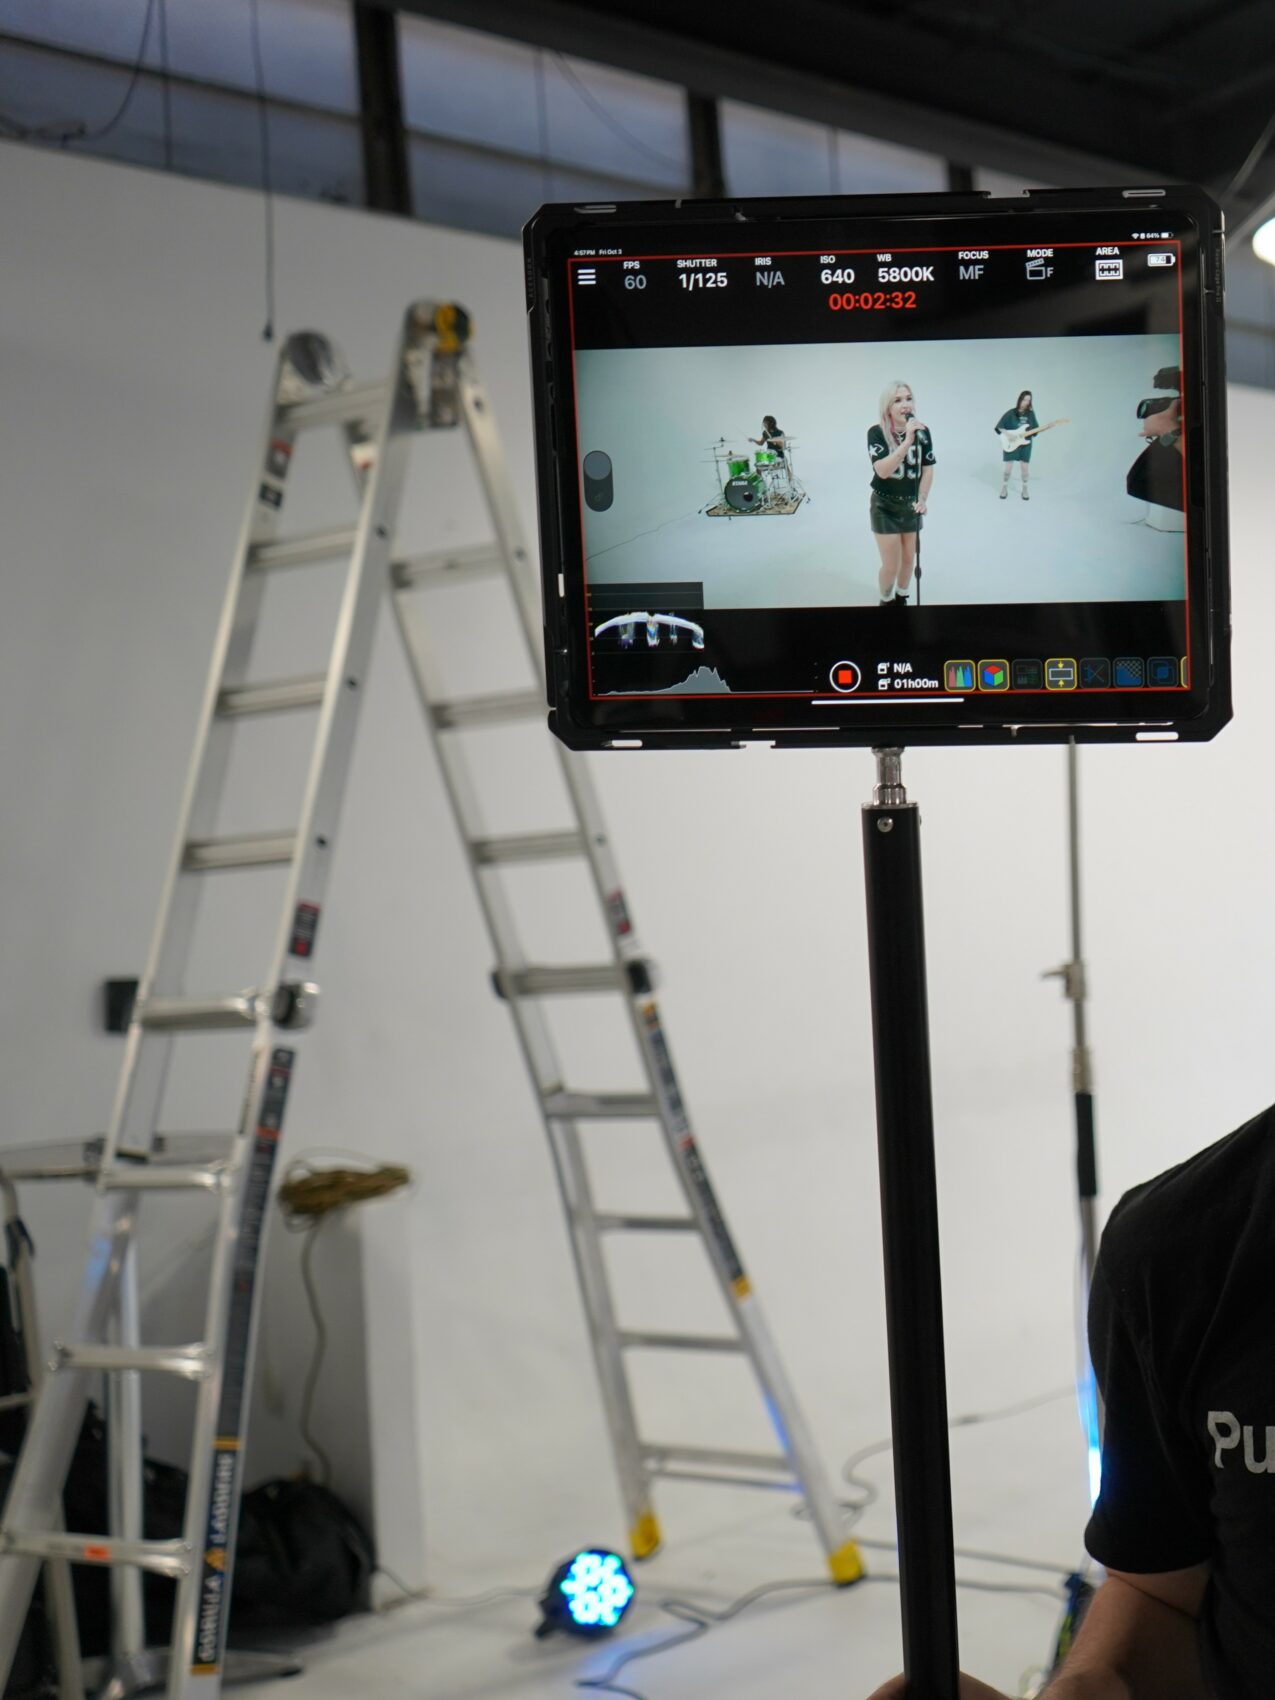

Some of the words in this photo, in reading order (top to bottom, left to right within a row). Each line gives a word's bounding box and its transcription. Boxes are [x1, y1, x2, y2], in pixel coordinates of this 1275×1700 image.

[958, 250, 989, 260] FOCUS
[1026, 248, 1054, 258] MODE
[1095, 246, 1120, 256] AREA
[754, 256, 772, 266] IRIS
[819, 255, 836, 264] ISO
[876, 253, 892, 262] WB
[623, 260, 641, 270] FPS
[676, 258, 718, 268] SHUTTER
[820, 268, 855, 285] 640
[877, 266, 935, 283] 5800K
[958, 264, 985, 280] MF
[624, 274, 647, 290] 60
[678, 271, 728, 291] 1/125
[755, 270, 785, 288] N/A
[828, 290, 917, 311] 00:02:32
[893, 663, 912, 675] N/A
[894, 678, 939, 688] 01h00m
